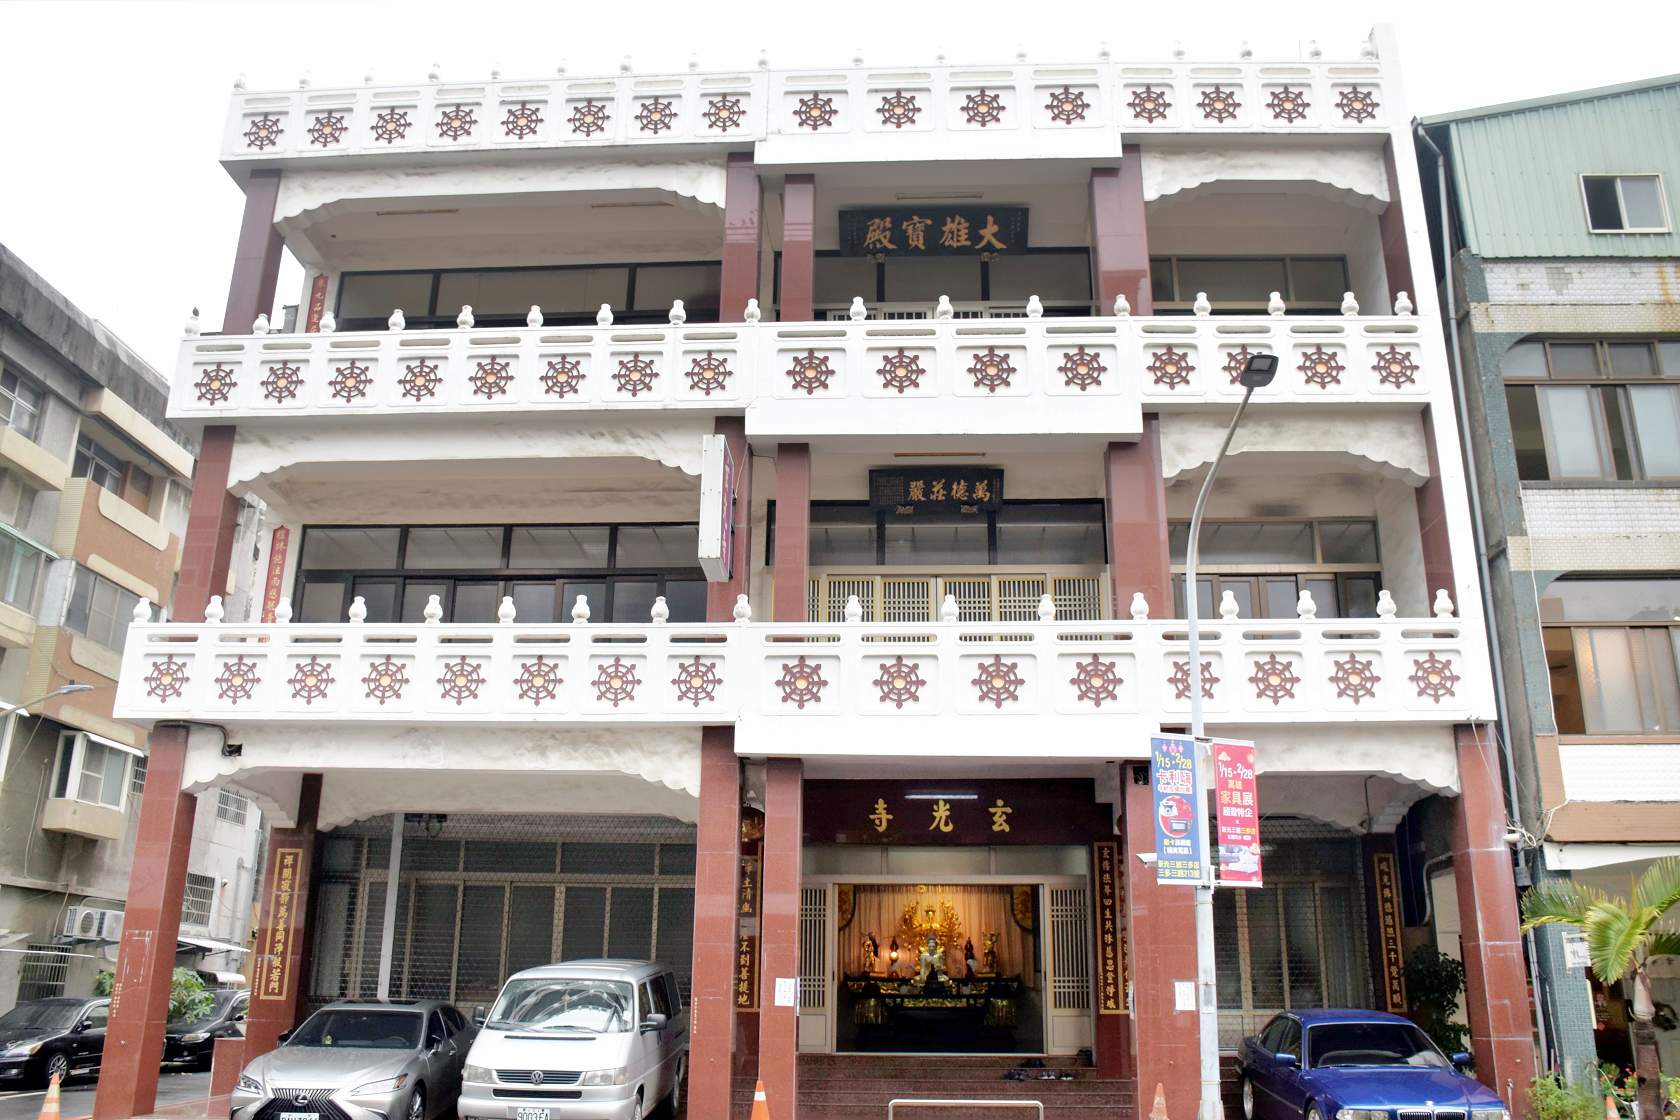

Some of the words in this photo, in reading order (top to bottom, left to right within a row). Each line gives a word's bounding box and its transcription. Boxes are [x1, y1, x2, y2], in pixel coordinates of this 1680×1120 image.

[863, 215, 1008, 250] 大雄寶殿
[868, 798, 1012, 833] 玄光寺
[1220, 790, 1254, 806] 家具展
